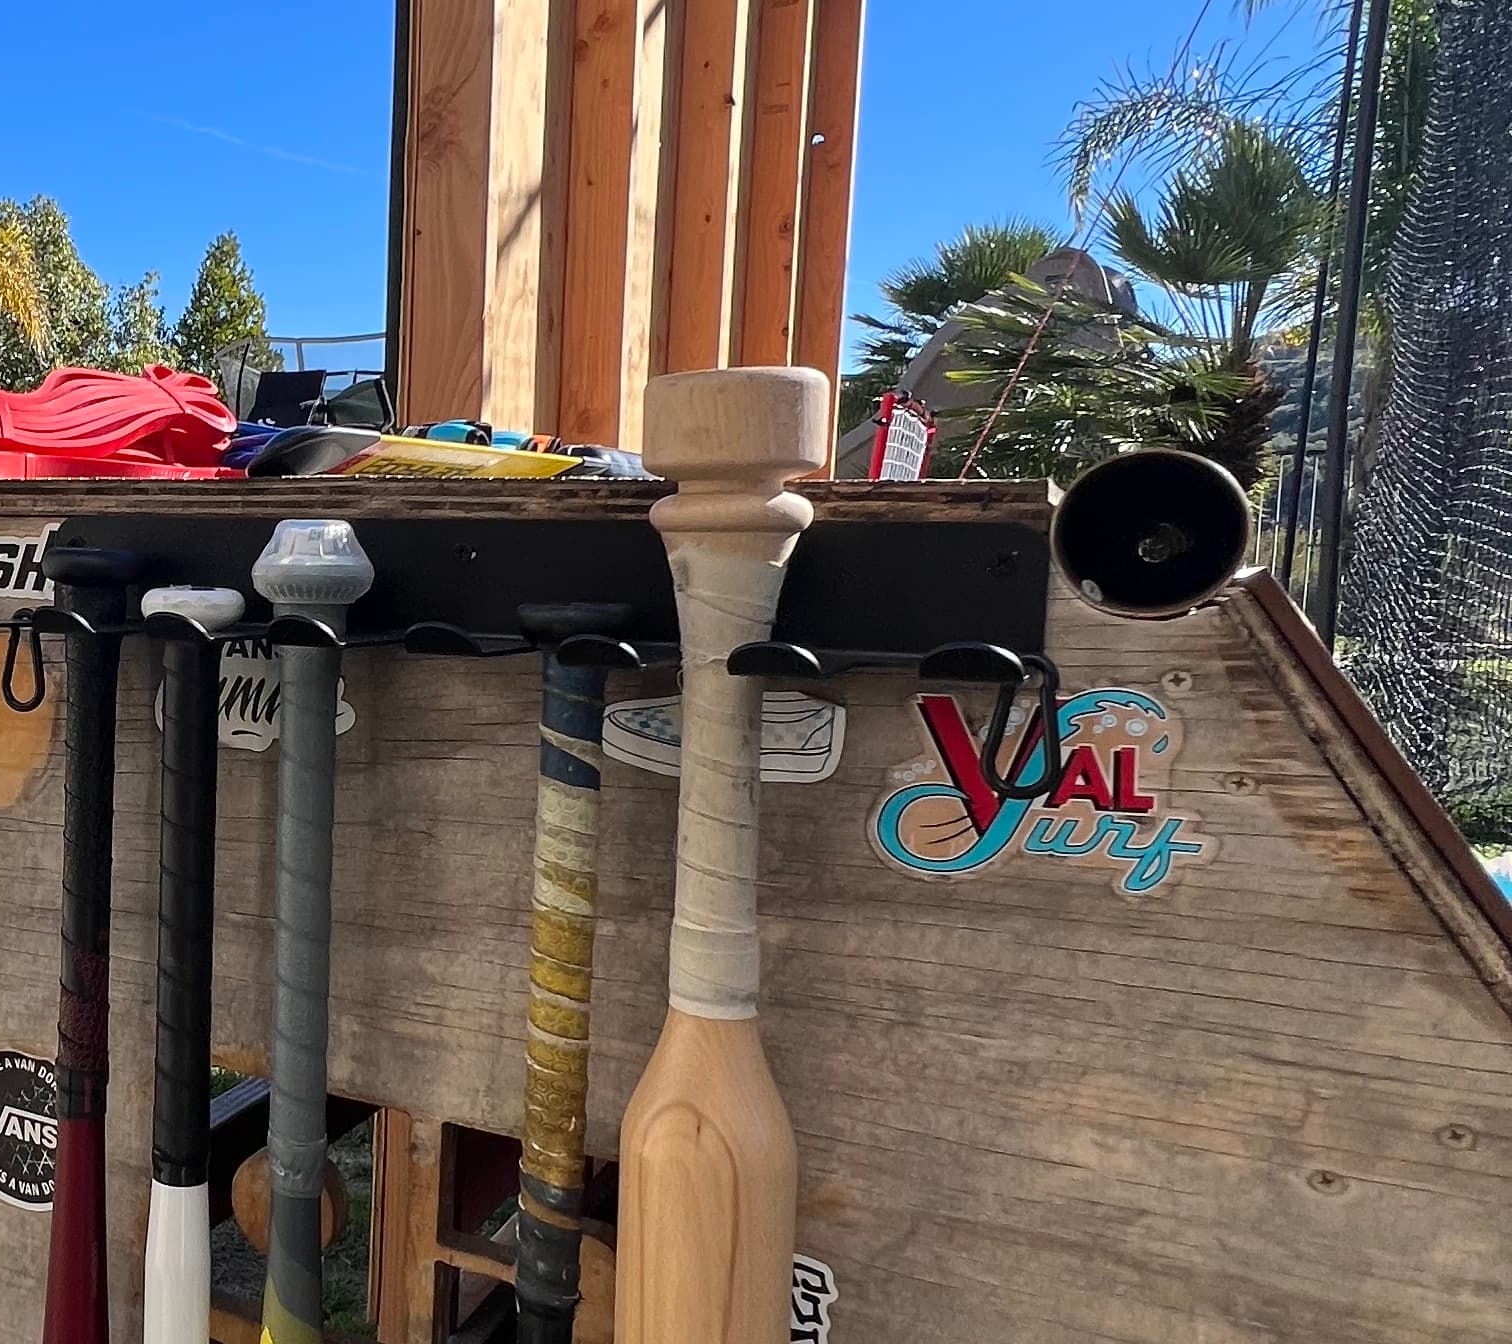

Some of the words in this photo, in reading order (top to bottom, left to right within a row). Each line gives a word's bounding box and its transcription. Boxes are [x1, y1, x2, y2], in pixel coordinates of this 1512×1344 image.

[916, 692, 1157, 840] VAL
[4, 1057, 14, 1070] A
[14, 1057, 37, 1074] VAN
[8, 1176, 17, 1191] A
[18, 1180, 41, 1197] VAN
